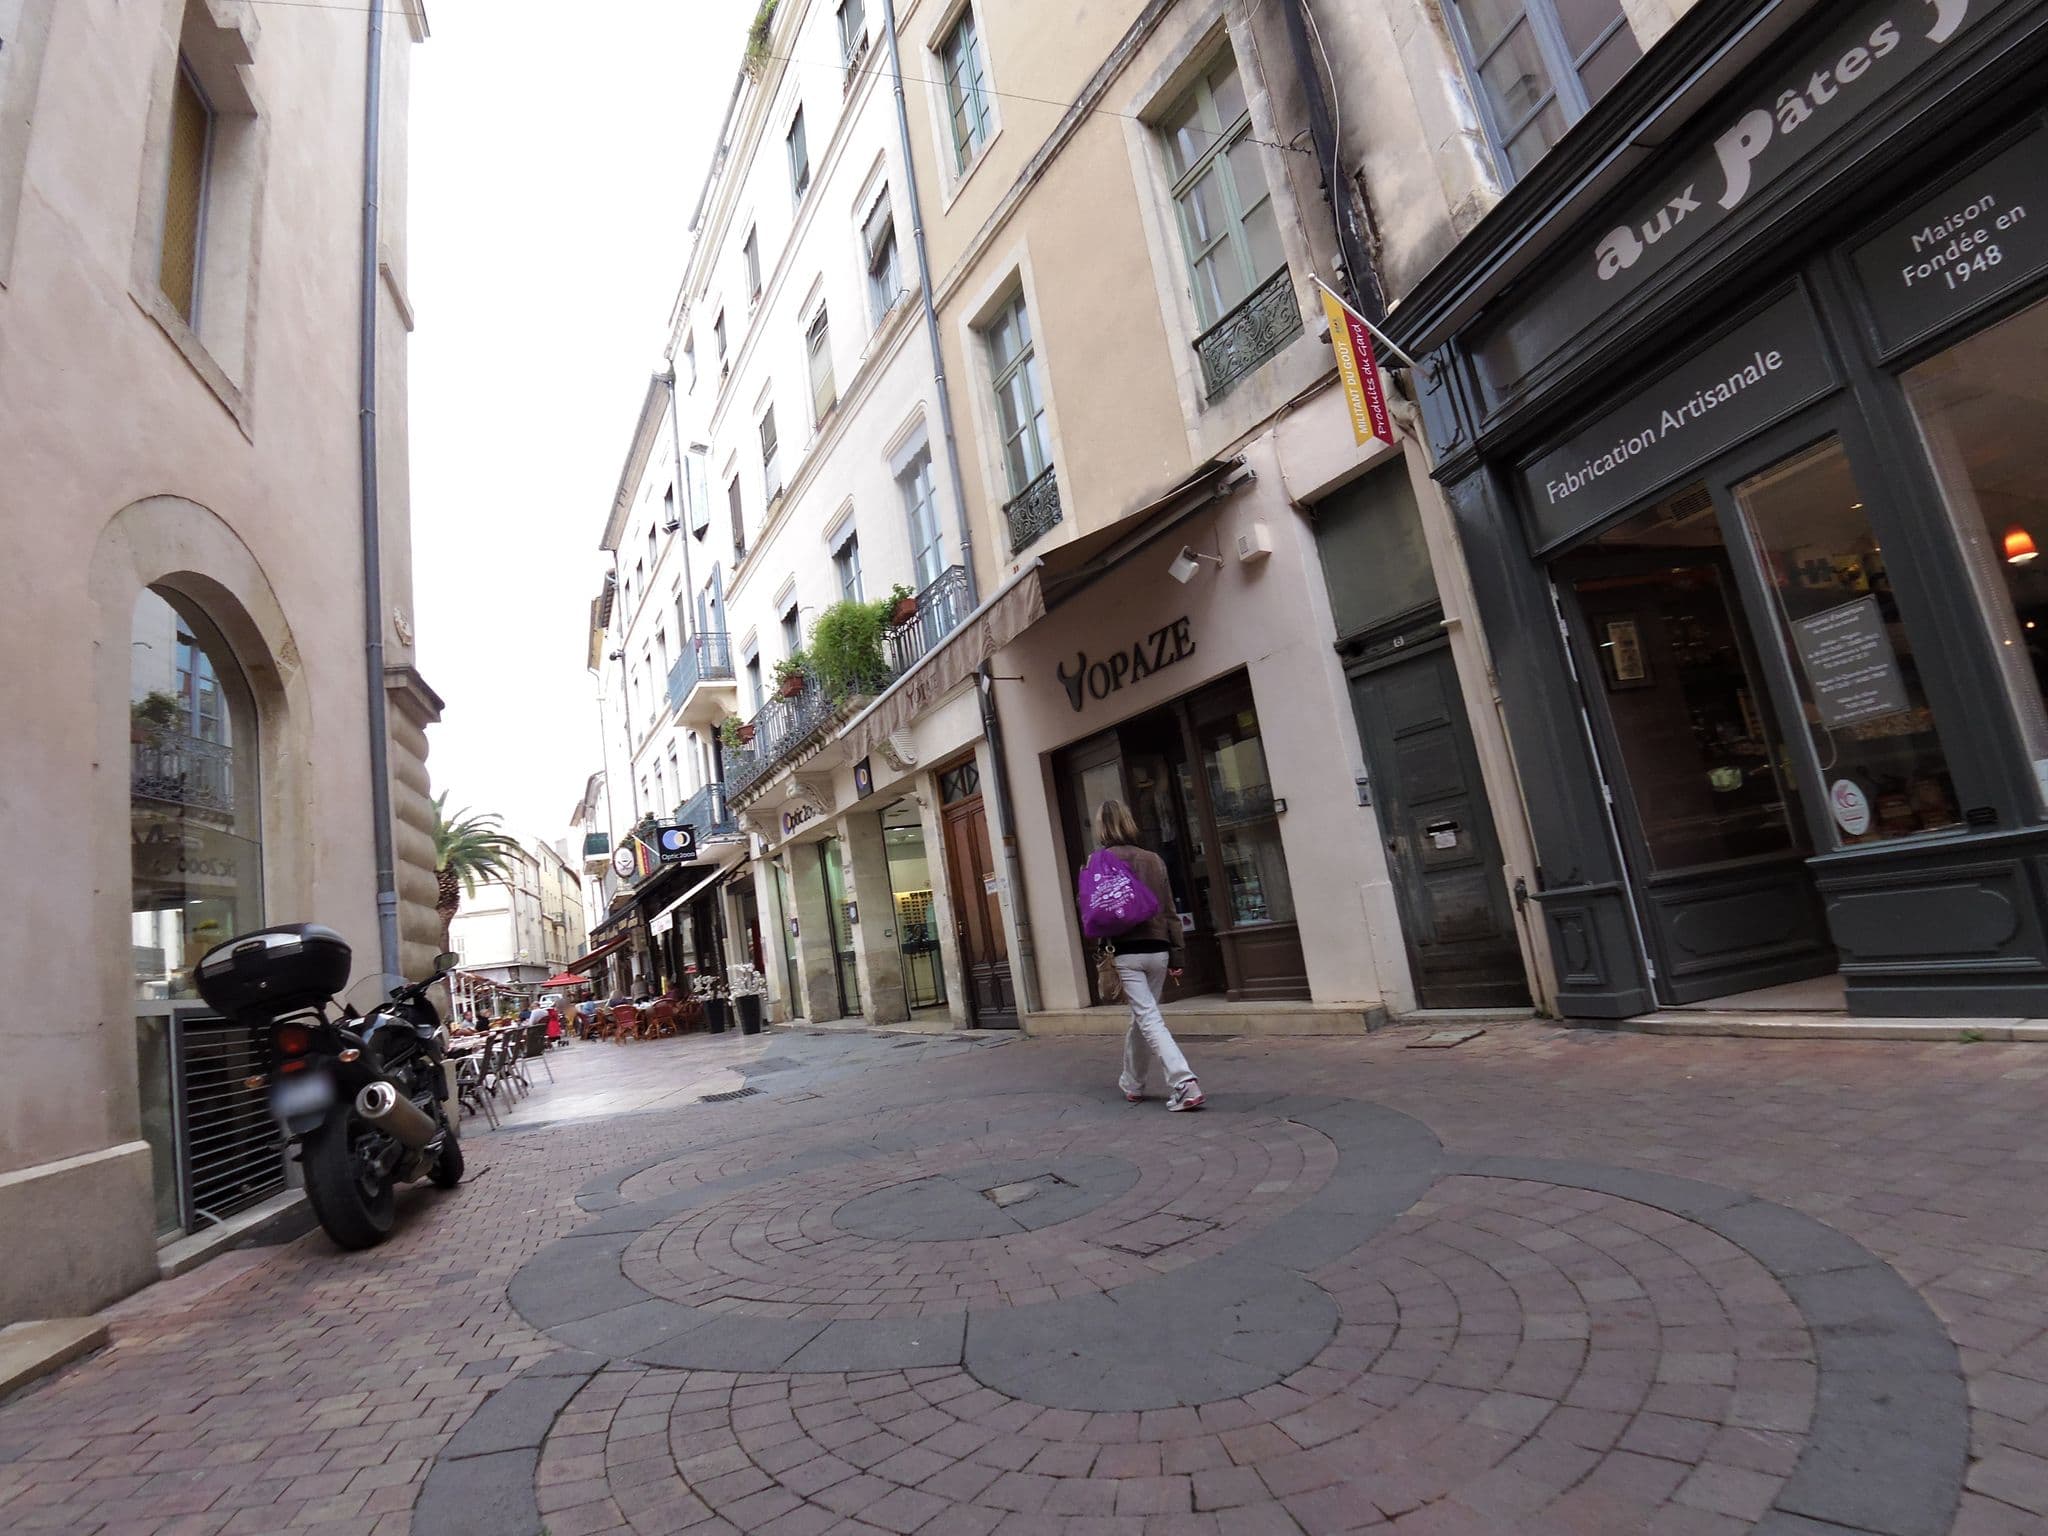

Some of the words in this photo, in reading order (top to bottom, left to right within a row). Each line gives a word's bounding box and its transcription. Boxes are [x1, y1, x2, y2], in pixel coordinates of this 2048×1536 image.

[1714, 19, 1900, 210] Pâtes
[1902, 228, 1989, 287] Fondée
[1995, 205, 2027, 230] en
[1910, 195, 1996, 253] Maison
[1945, 244, 2003, 290] 1948
[1351, 323, 1369, 355] Gard
[1346, 369, 1358, 386] DU
[1360, 357, 1373, 375] du
[1349, 389, 1369, 435] MILITANT
[1363, 378, 1388, 435] Produits
[1546, 428, 1656, 504] Fabrication
[1660, 350, 1784, 438] Artisanale
